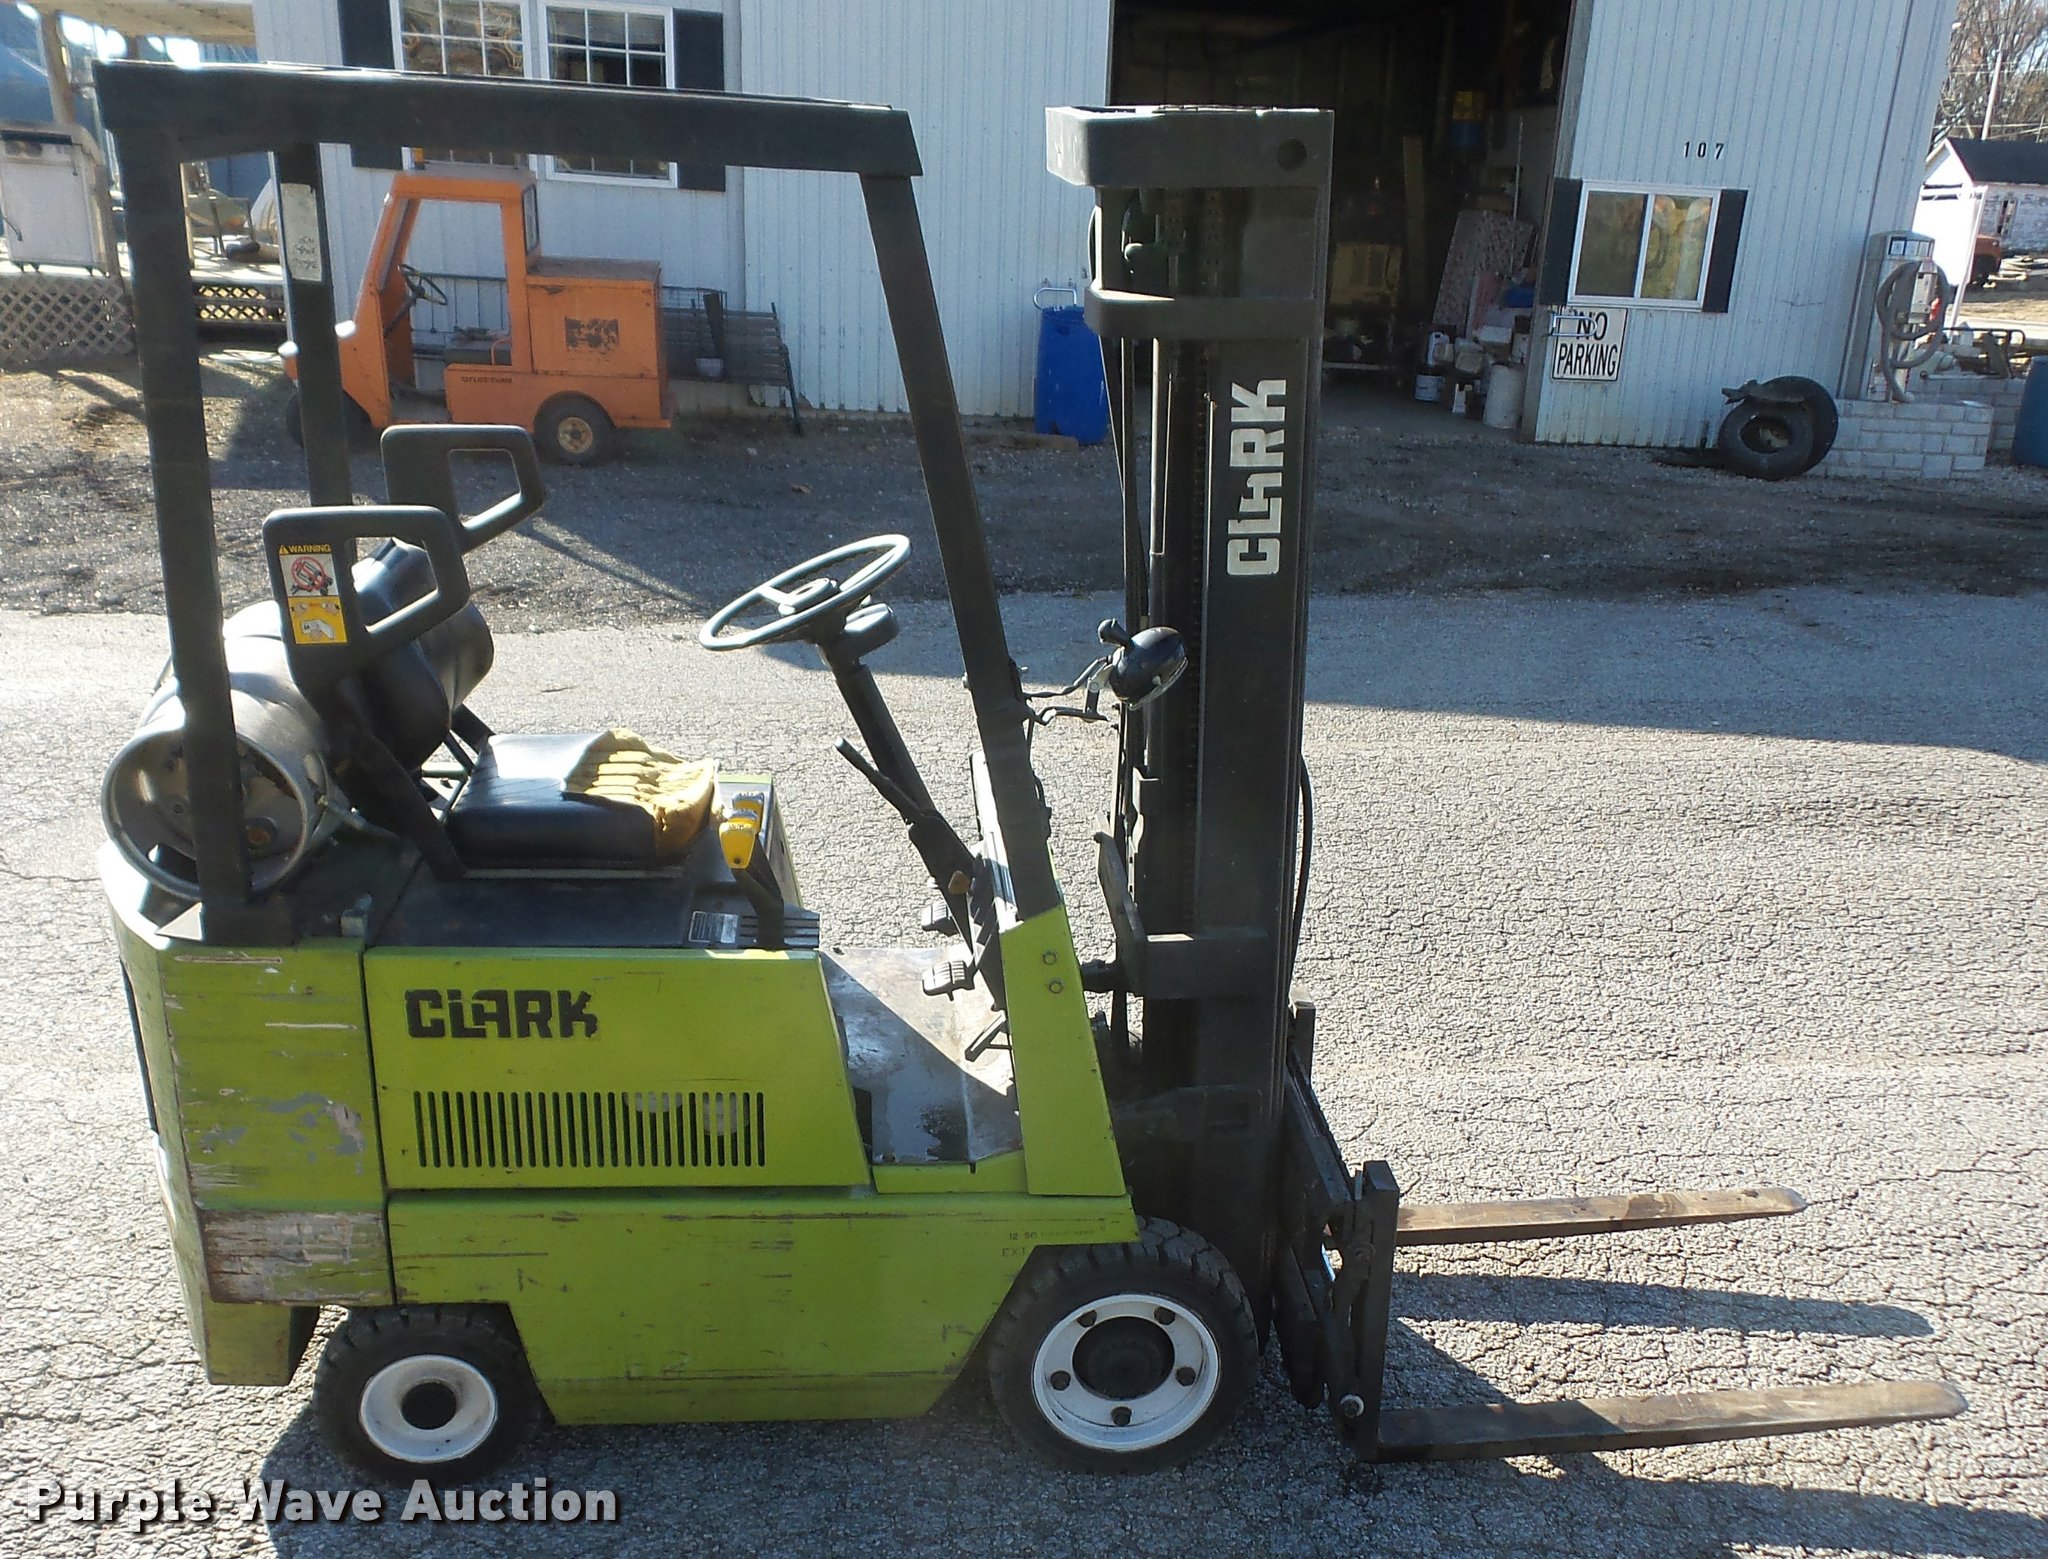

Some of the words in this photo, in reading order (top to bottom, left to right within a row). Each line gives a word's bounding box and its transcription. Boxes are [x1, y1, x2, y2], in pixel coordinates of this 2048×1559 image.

[1683, 141, 1724, 160] 107
[1576, 311, 1608, 341] NO
[1556, 343, 1618, 376] PARKING
[1226, 379, 1287, 576] CLARK
[288, 544, 331, 553] WARNING
[404, 989, 599, 1039] CLARK
